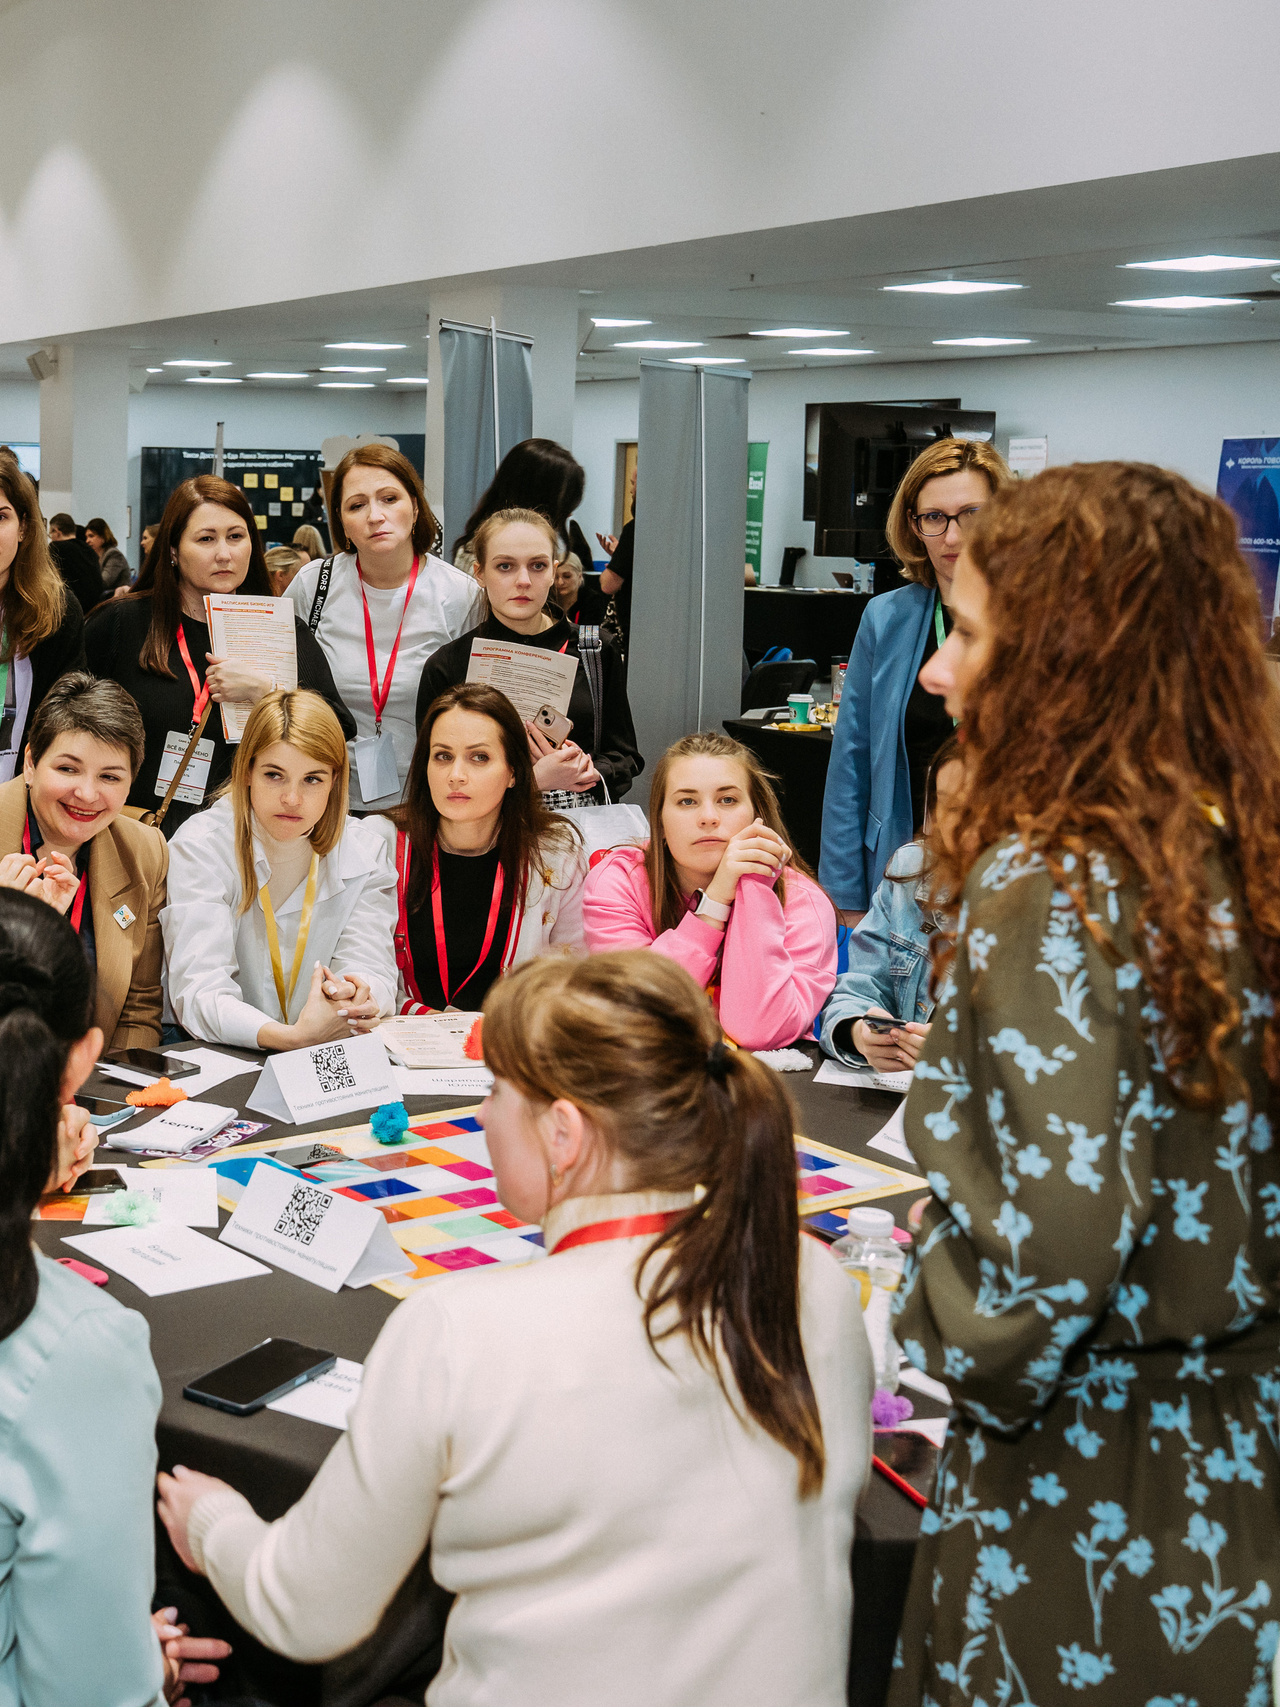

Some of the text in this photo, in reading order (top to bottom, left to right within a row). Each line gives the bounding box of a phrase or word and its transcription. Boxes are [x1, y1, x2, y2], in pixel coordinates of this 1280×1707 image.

[319, 569, 330, 591] KORS
[310, 595, 324, 626] MICHAEL
[482, 646, 514, 654] ПРОГРАММА
[514, 650, 552, 662] КОНФЕРЕНЦИИ
[293, 1102, 314, 1112] Техники
[159, 1118, 205, 1132] Lerna
[232, 1220, 253, 1236] Техники
